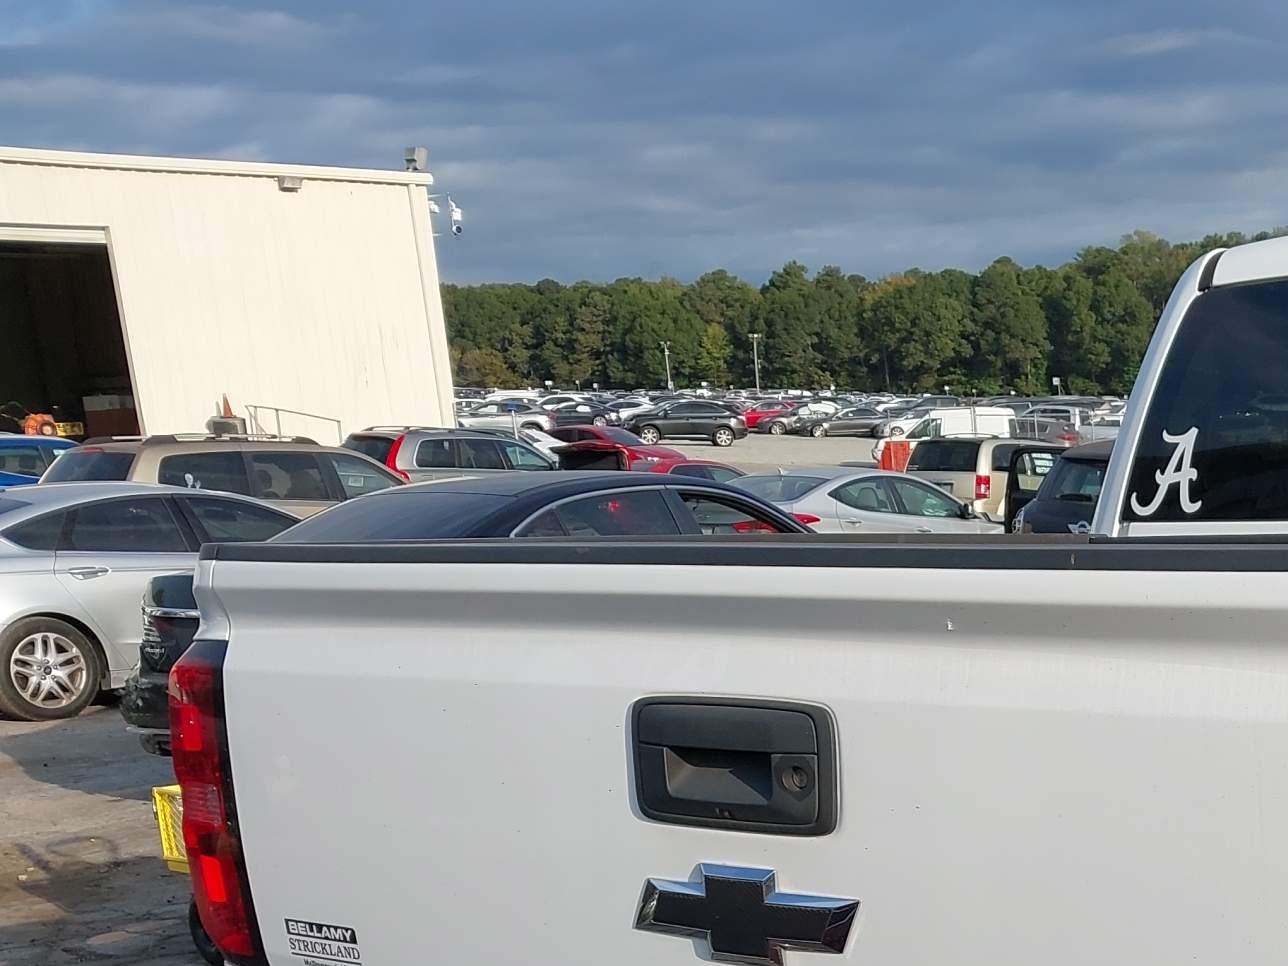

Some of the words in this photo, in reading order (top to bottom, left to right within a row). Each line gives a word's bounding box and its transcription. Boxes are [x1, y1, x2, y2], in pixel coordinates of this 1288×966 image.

[1131, 426, 1202, 516] A
[287, 920, 352, 942] BELLAMY
[288, 937, 361, 960] STRICKLAND
